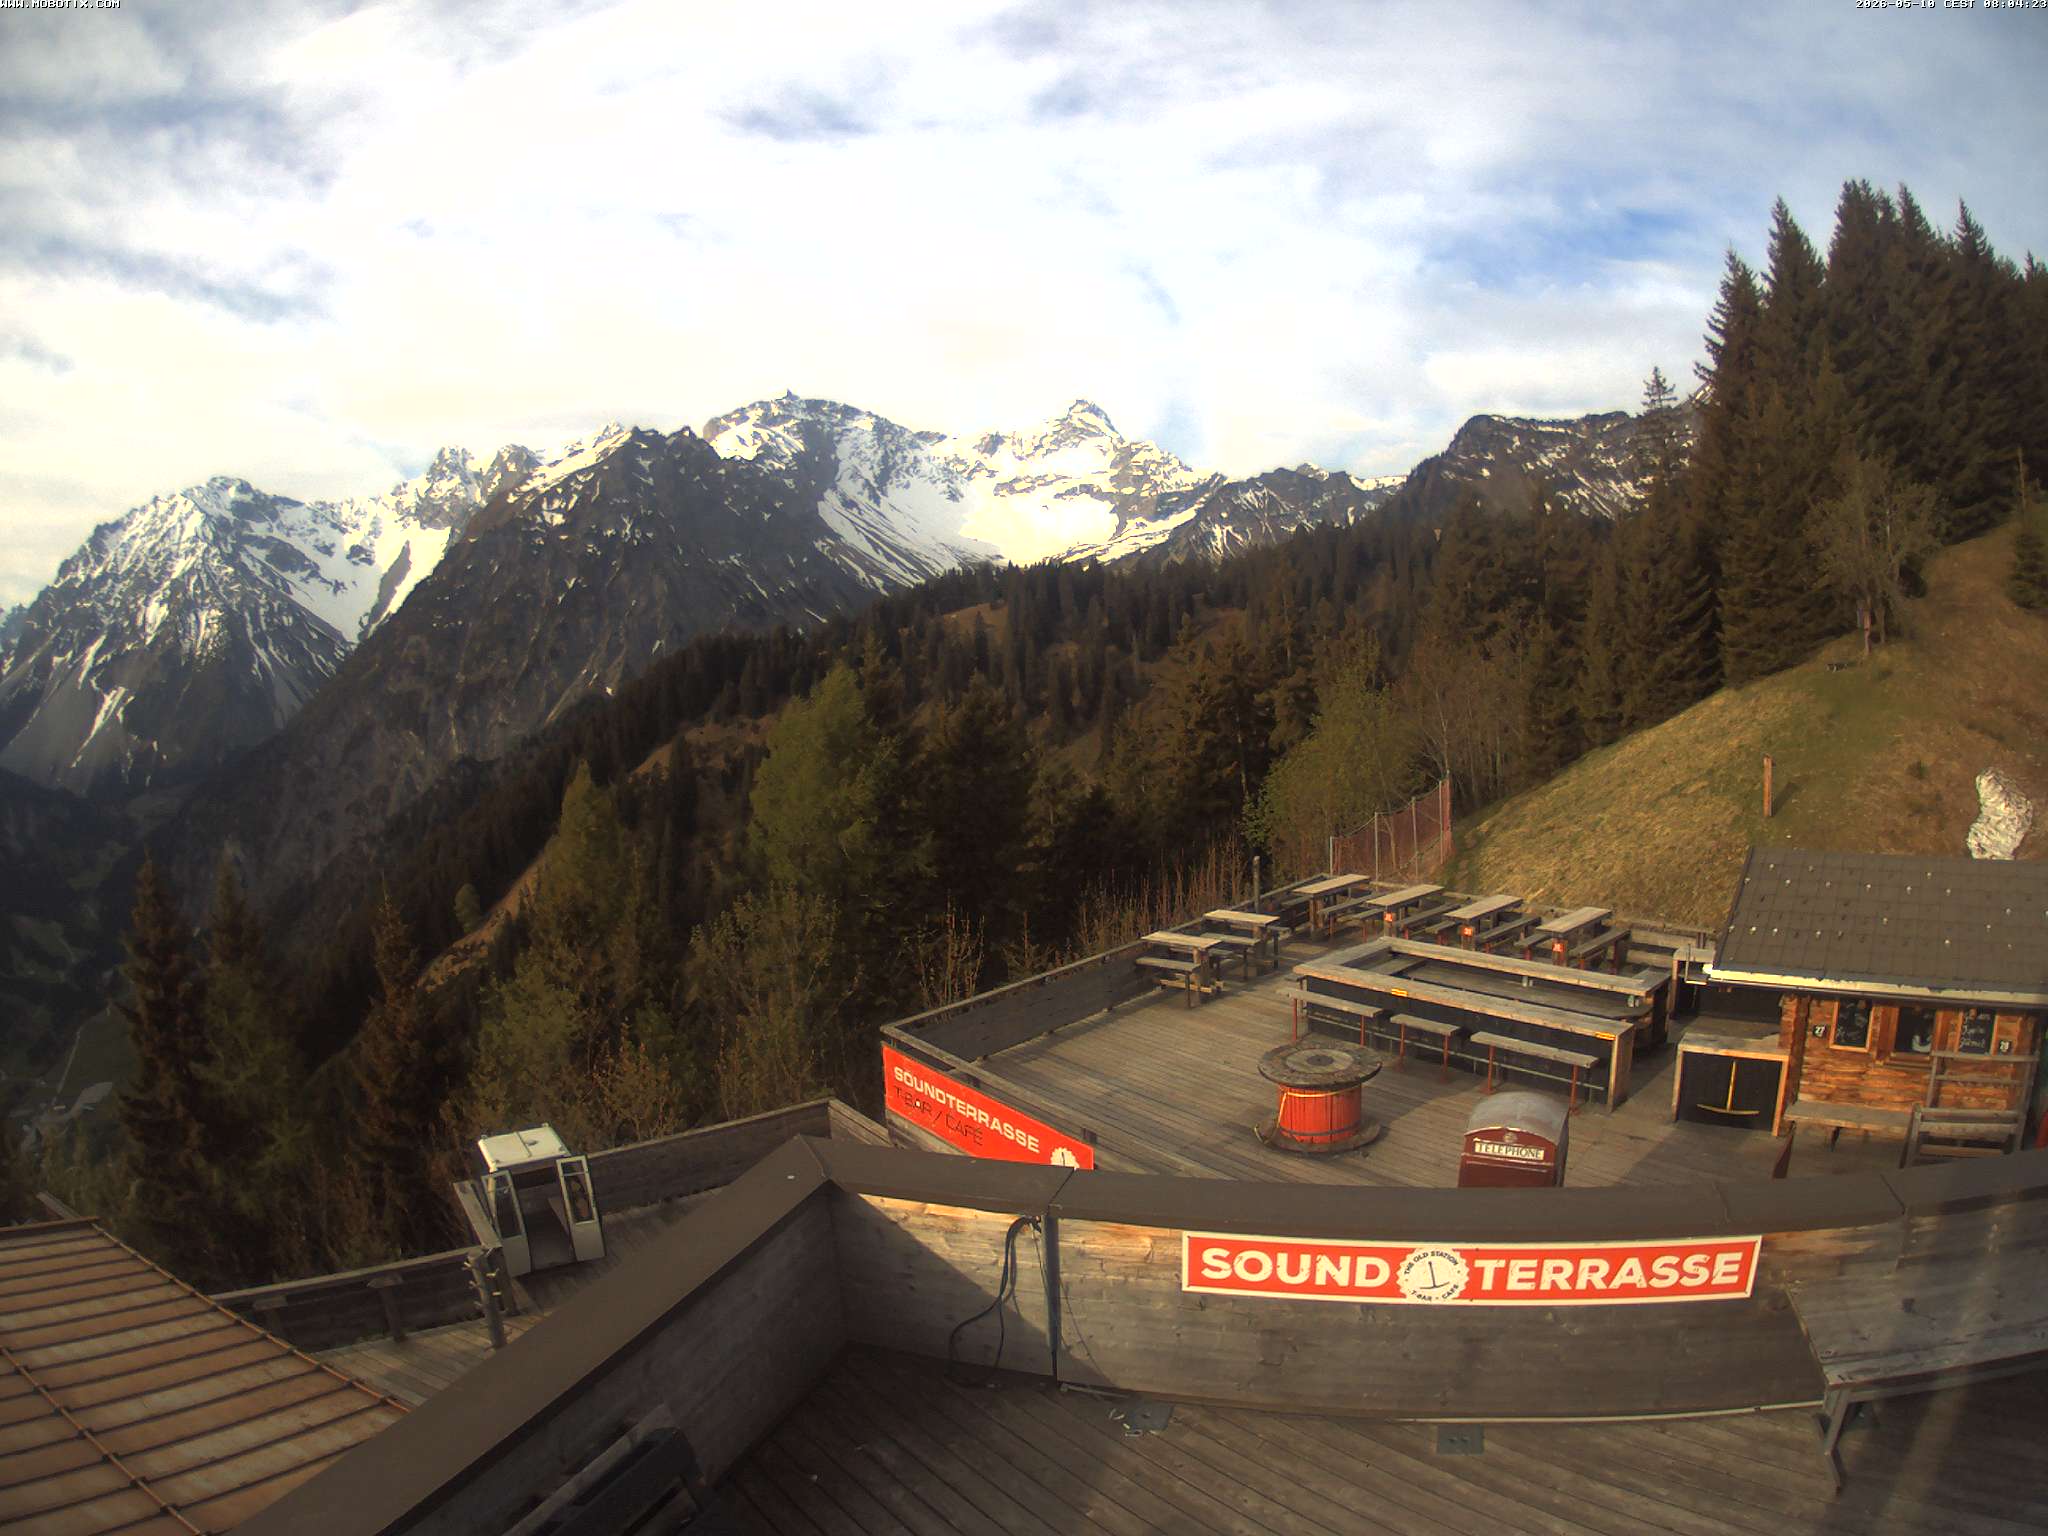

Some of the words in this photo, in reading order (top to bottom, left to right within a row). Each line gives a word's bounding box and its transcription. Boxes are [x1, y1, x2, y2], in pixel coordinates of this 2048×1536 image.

[894, 1066, 1040, 1154] SOUNDTERRASSE
[1478, 1142, 1541, 1160] TELEPHONE
[1201, 1247, 1391, 1288] SOUND
[1473, 1252, 1744, 1291] TERRASSE
[1404, 1261, 1415, 1275] THE
[1413, 1252, 1429, 1263] OLD
